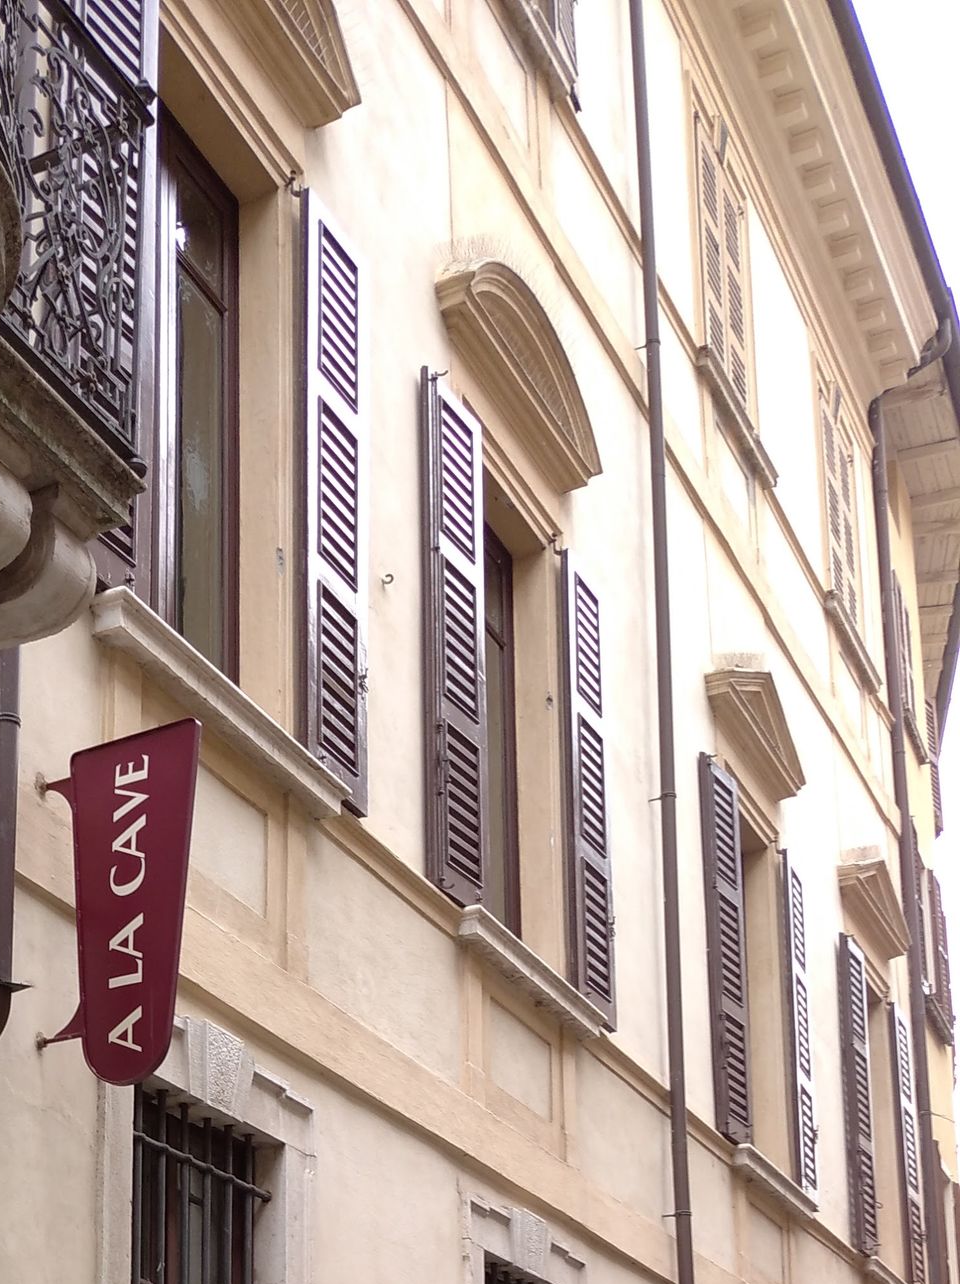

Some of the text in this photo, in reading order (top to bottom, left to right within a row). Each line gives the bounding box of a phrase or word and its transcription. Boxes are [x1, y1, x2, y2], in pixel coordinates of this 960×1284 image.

[108, 752, 151, 1053] A LA CAVE
